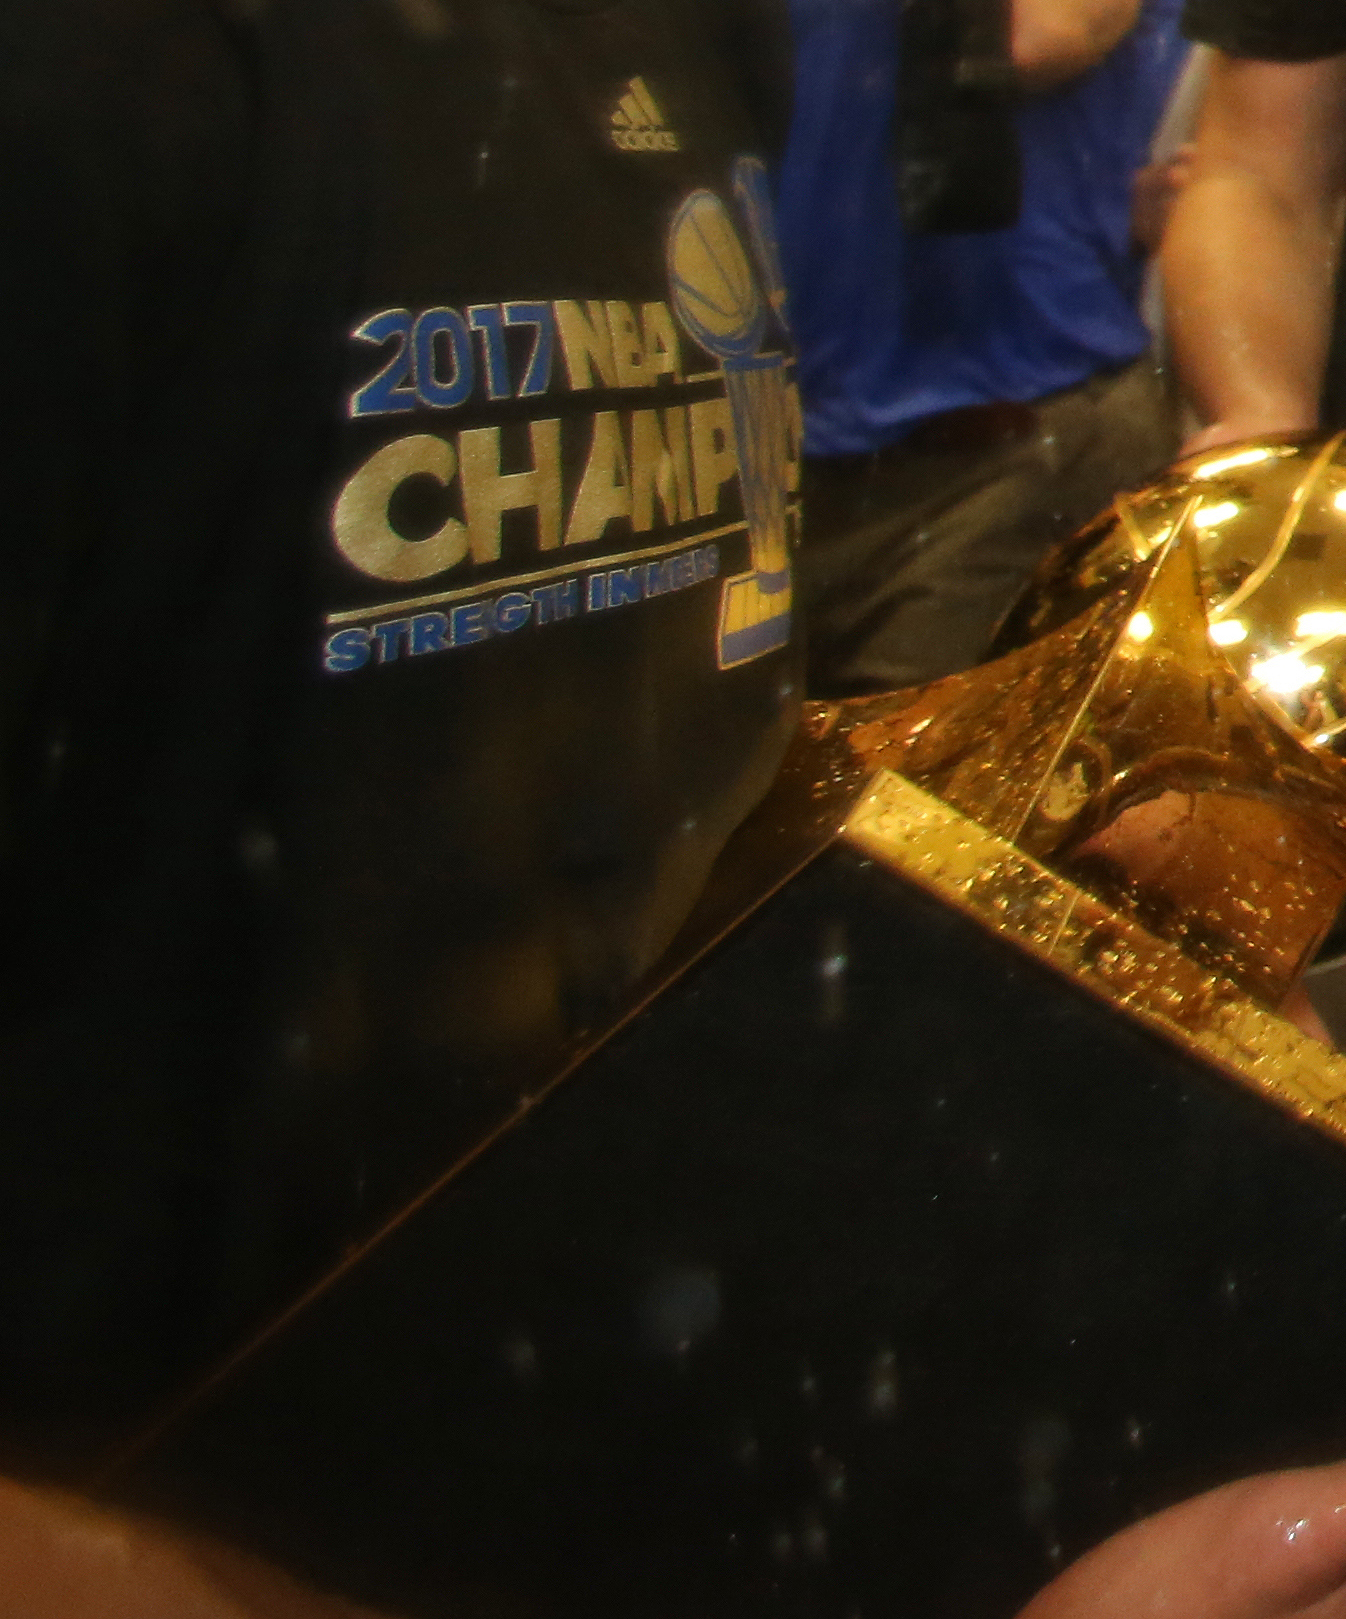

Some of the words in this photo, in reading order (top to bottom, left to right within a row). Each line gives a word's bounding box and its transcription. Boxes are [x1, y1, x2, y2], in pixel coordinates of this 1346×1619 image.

[350, 302, 553, 418] 2017
[552, 299, 684, 390] NBA
[326, 576, 579, 673] STREGTH
